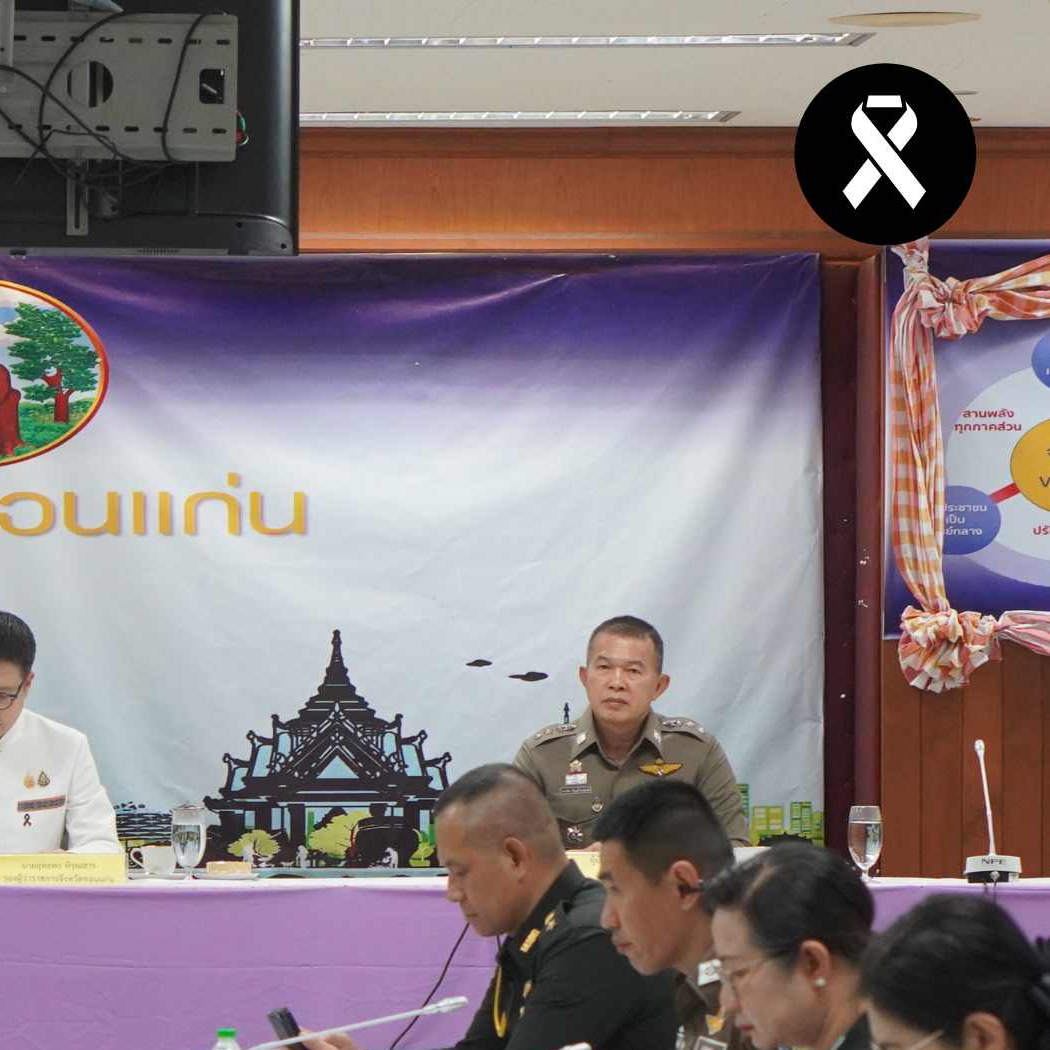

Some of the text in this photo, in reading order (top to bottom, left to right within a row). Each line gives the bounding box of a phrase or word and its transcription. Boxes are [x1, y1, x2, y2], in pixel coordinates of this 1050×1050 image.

[962, 408, 1014, 418] สานพลัง
[954, 421, 1022, 434] ทุกภาคส่วน
